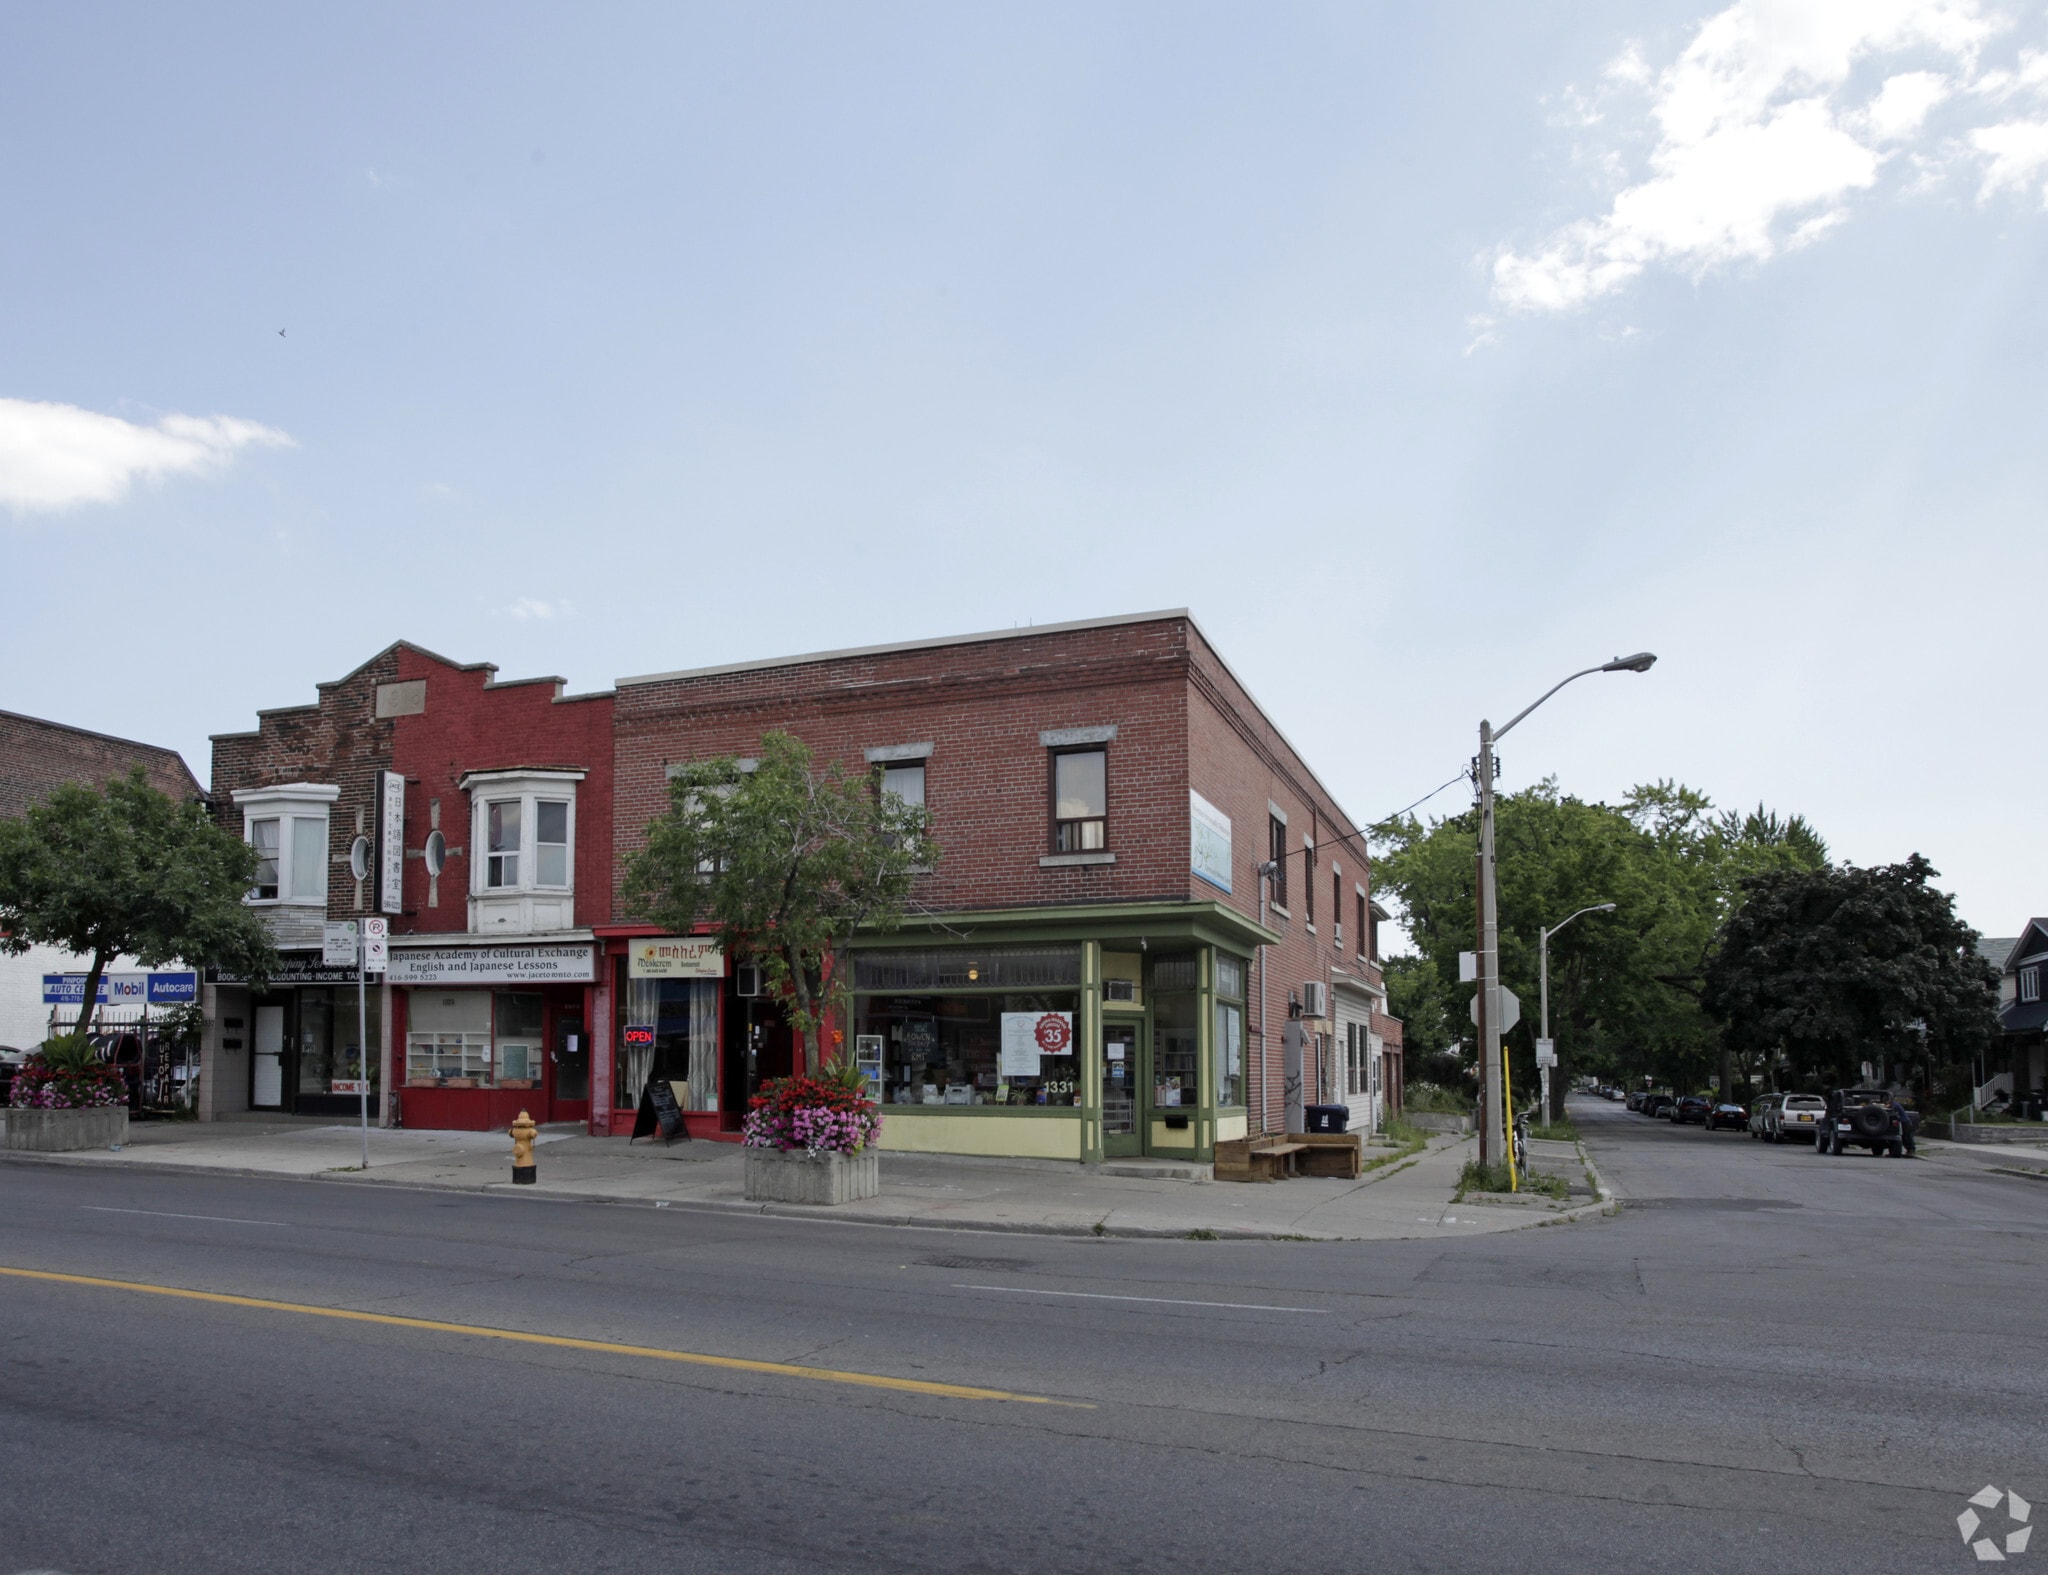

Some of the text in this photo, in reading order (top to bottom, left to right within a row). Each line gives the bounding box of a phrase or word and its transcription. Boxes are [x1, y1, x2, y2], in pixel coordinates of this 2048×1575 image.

[389, 947, 589, 963] Japanese Academy of Cultural Exchange
[410, 960, 558, 973] English and Japanese Lessons
[50, 985, 72, 994] AUTO
[114, 981, 145, 996] Mobil
[153, 982, 194, 993] Autocare
[626, 1031, 652, 1042] OPEN
[333, 1082, 355, 1092] INCOME
[1044, 1081, 1074, 1093] 1331
